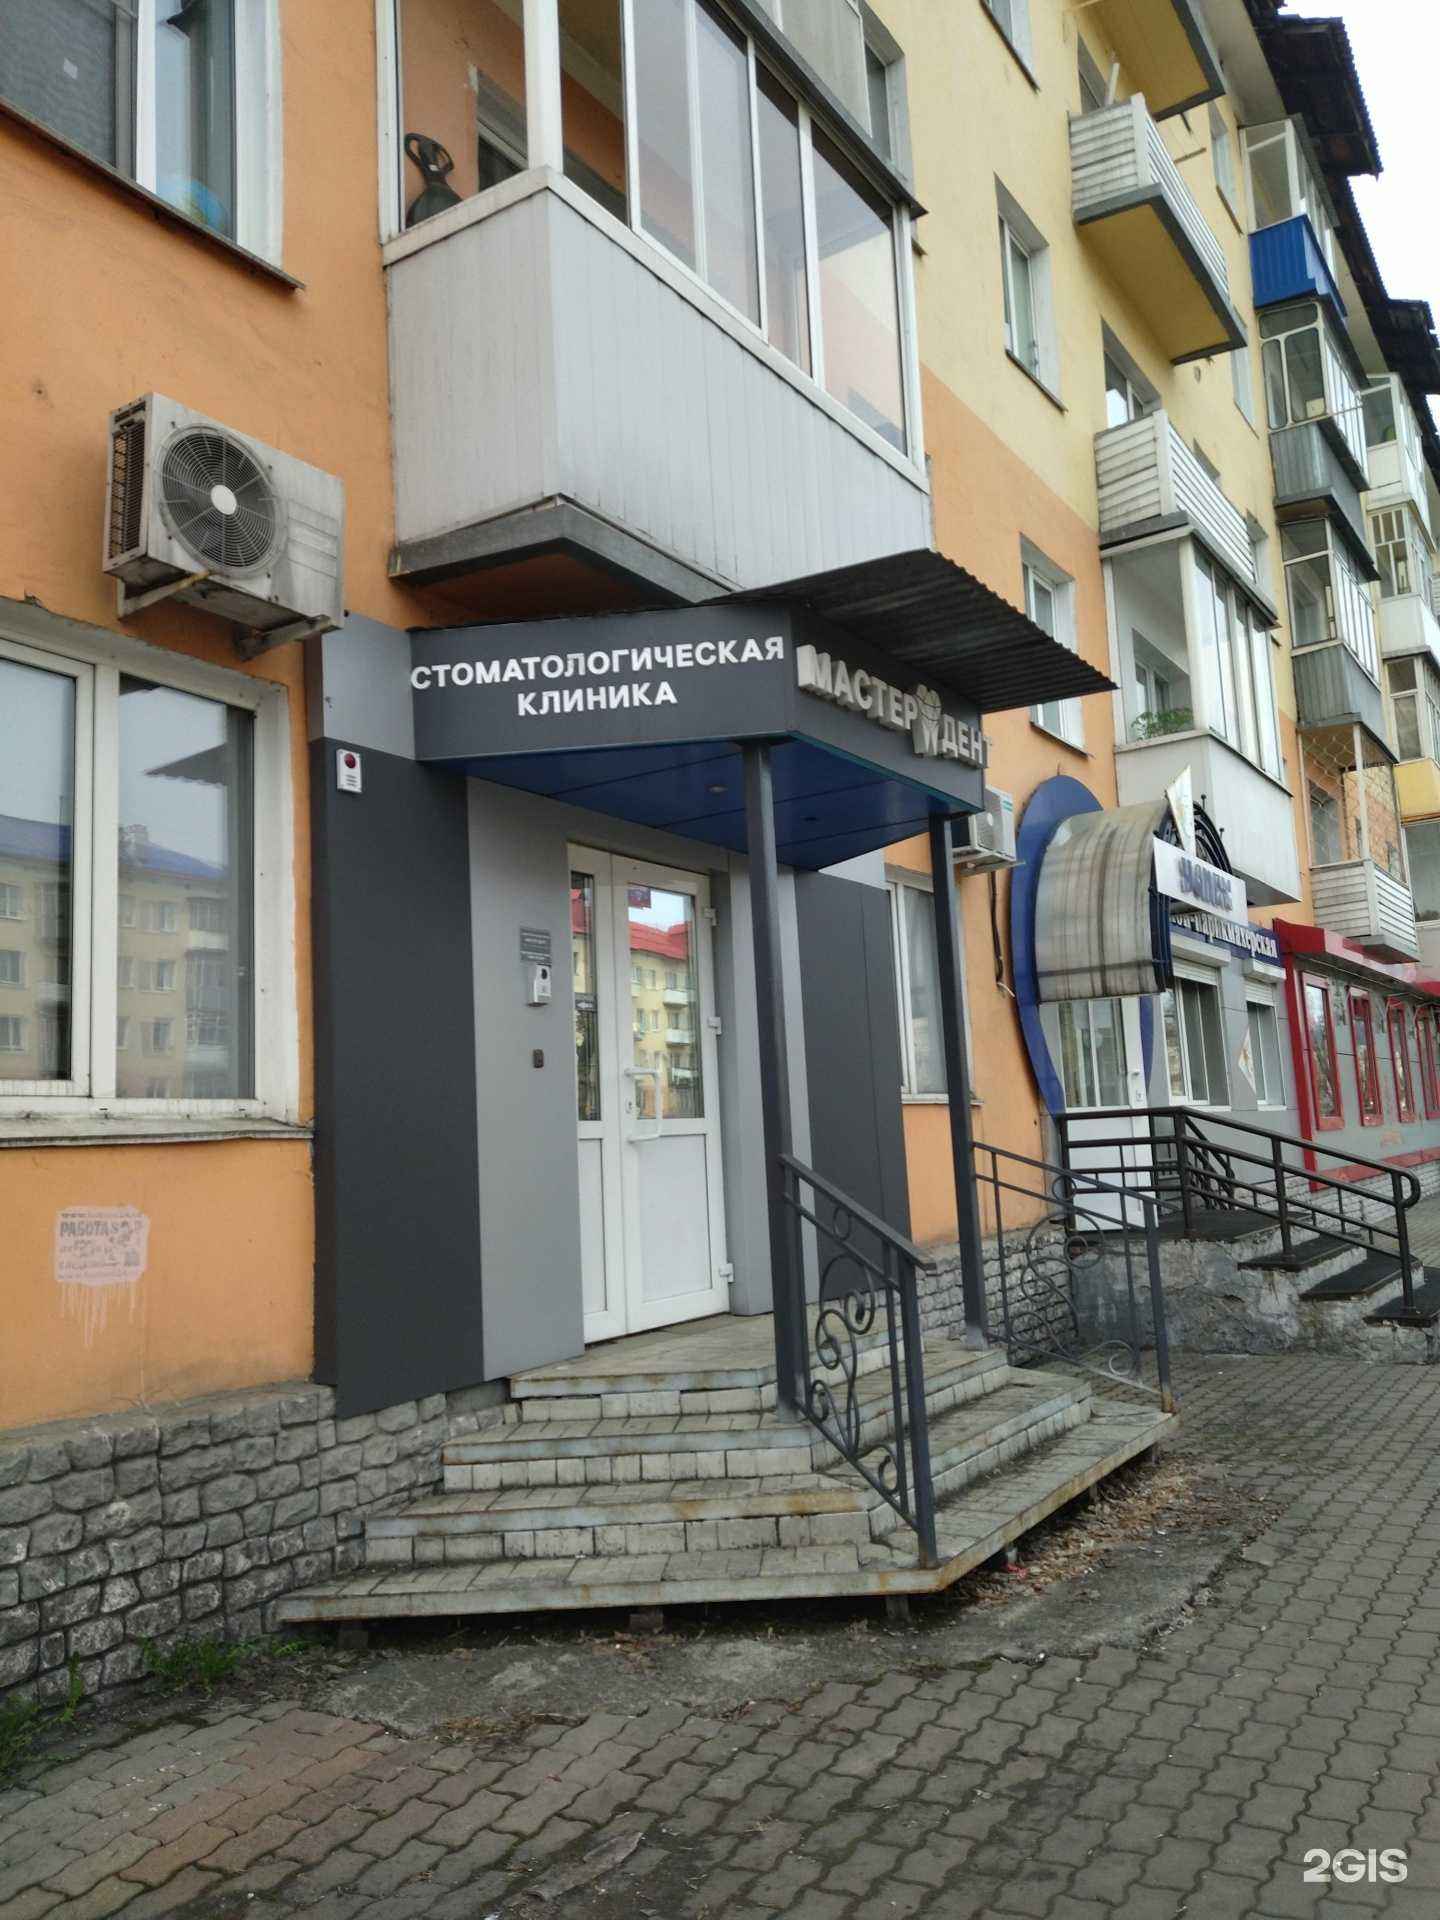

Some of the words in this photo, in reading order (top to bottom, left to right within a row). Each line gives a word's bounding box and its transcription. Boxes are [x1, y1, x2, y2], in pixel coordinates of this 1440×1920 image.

[410, 636, 785, 690] СТОМАТОЛОГИЧЕСКАЯ
[797, 644, 919, 731] МАСТЕР
[517, 681, 678, 716] КЛИНИКА
